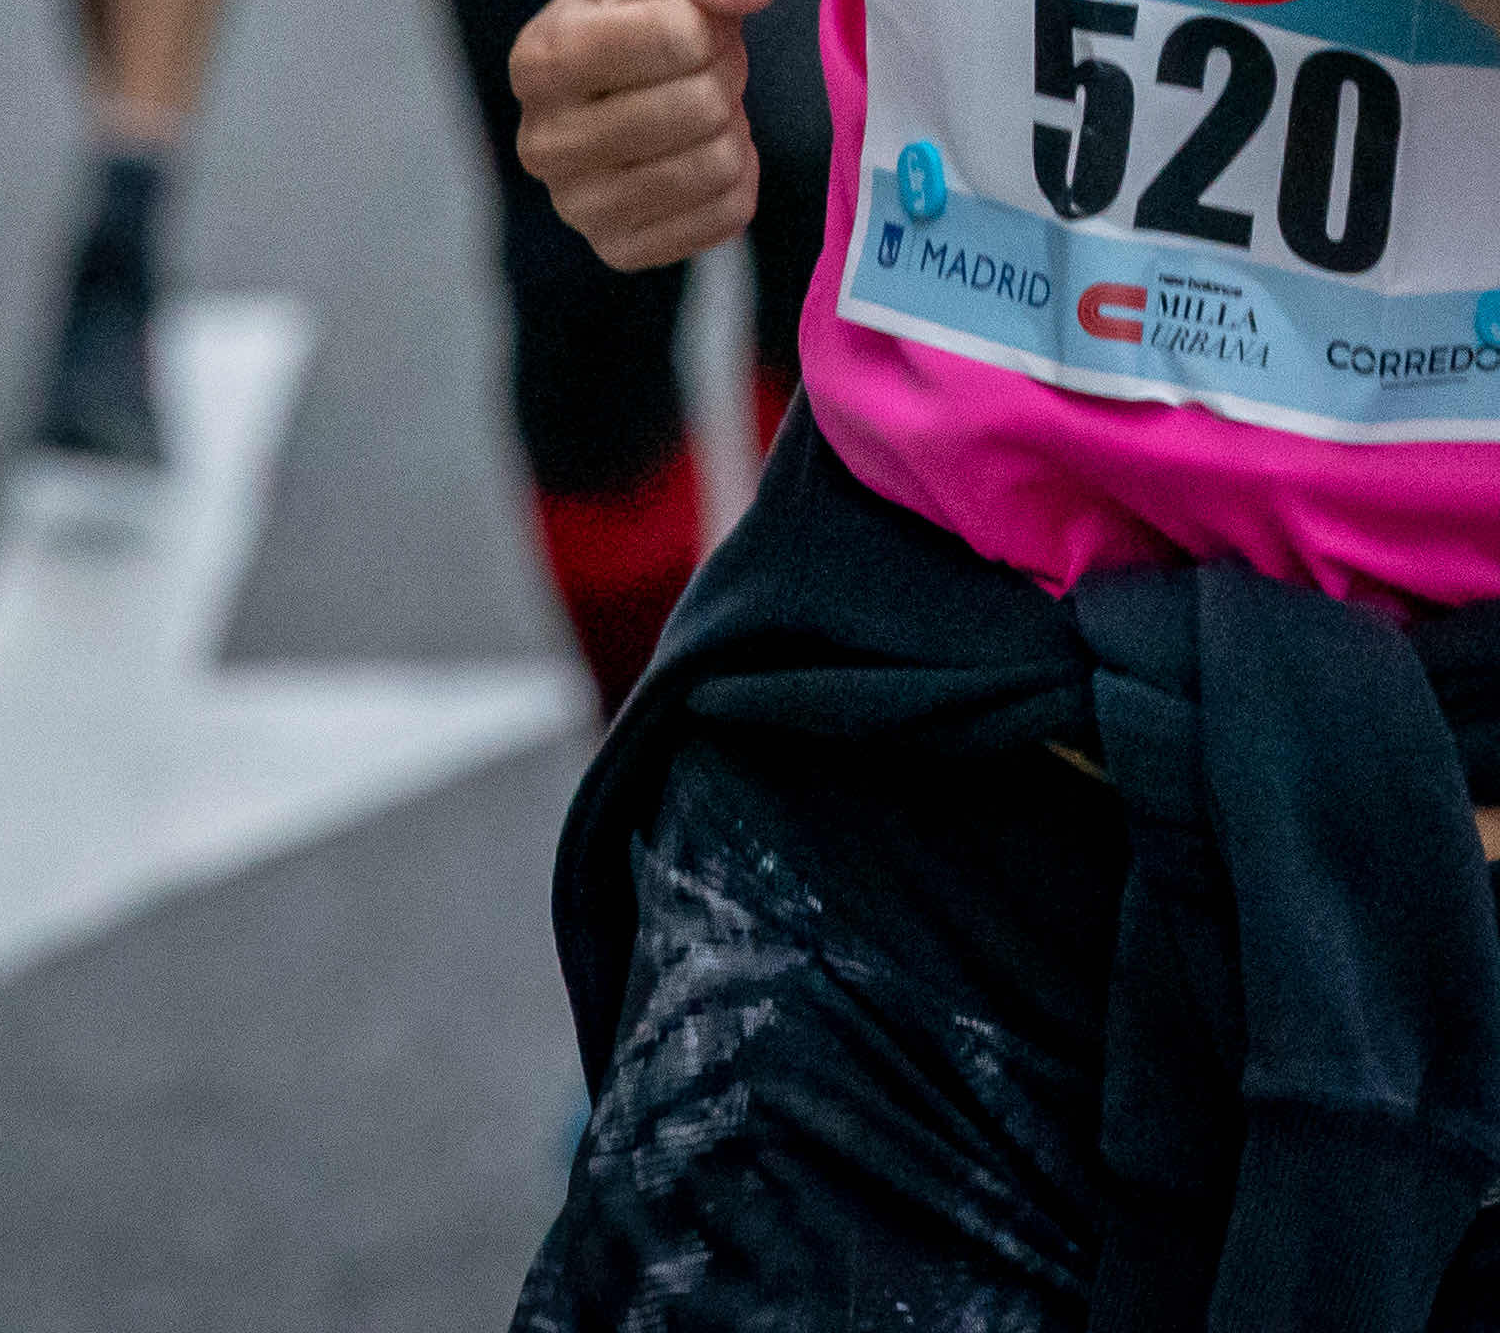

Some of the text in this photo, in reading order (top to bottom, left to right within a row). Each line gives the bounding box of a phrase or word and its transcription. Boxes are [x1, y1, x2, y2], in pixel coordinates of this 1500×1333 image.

[919, 237, 1052, 310] MADRID
[1157, 291, 1257, 333] MILLA
[1150, 324, 1269, 367] URBANA
